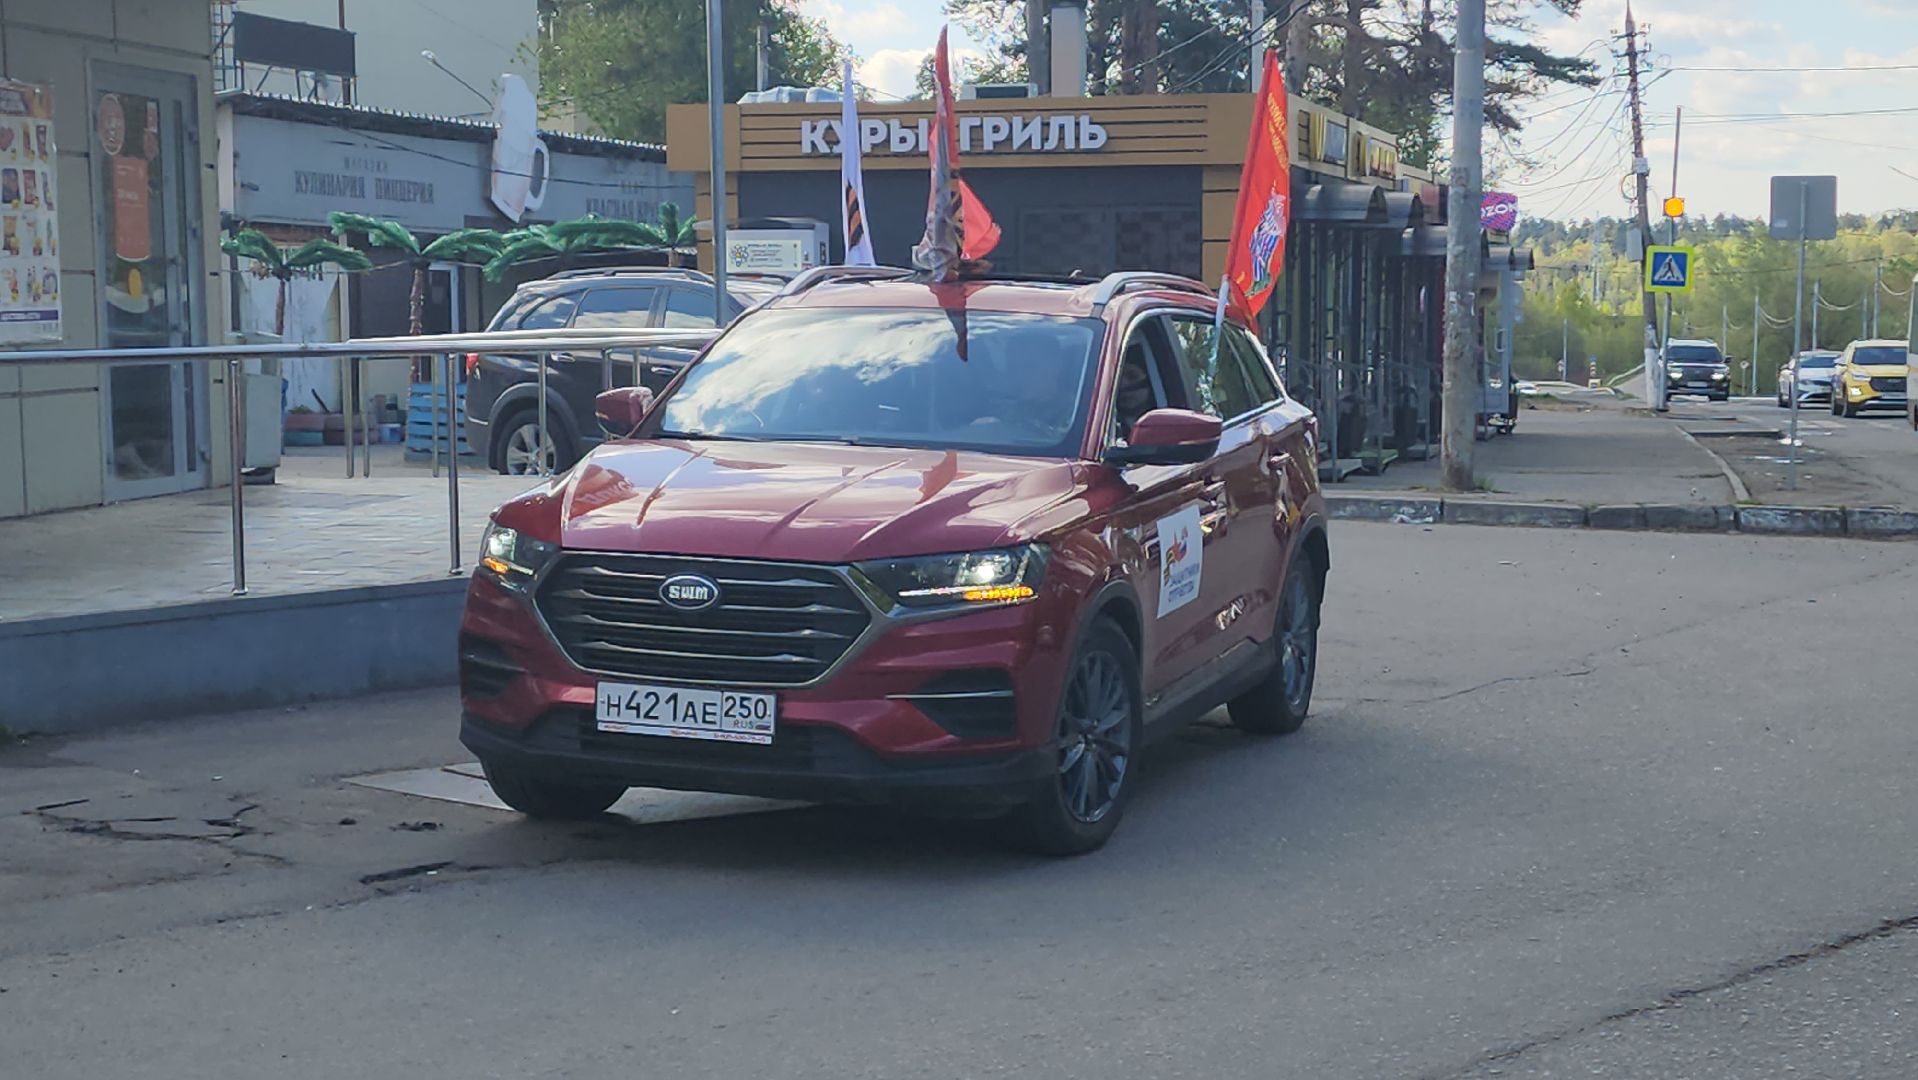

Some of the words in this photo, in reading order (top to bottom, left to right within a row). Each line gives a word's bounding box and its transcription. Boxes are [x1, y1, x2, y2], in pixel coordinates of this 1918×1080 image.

[959, 114, 1108, 151] ГРИЛЬ
[294, 169, 366, 199] КУЛИНАРИЯ
[374, 177, 434, 204] ПИЦЦЕРИЯ
[668, 584, 709, 601] SWM
[606, 689, 718, 725] Н421АЕ
[723, 695, 768, 720] 250
[733, 719, 754, 730] RUS
